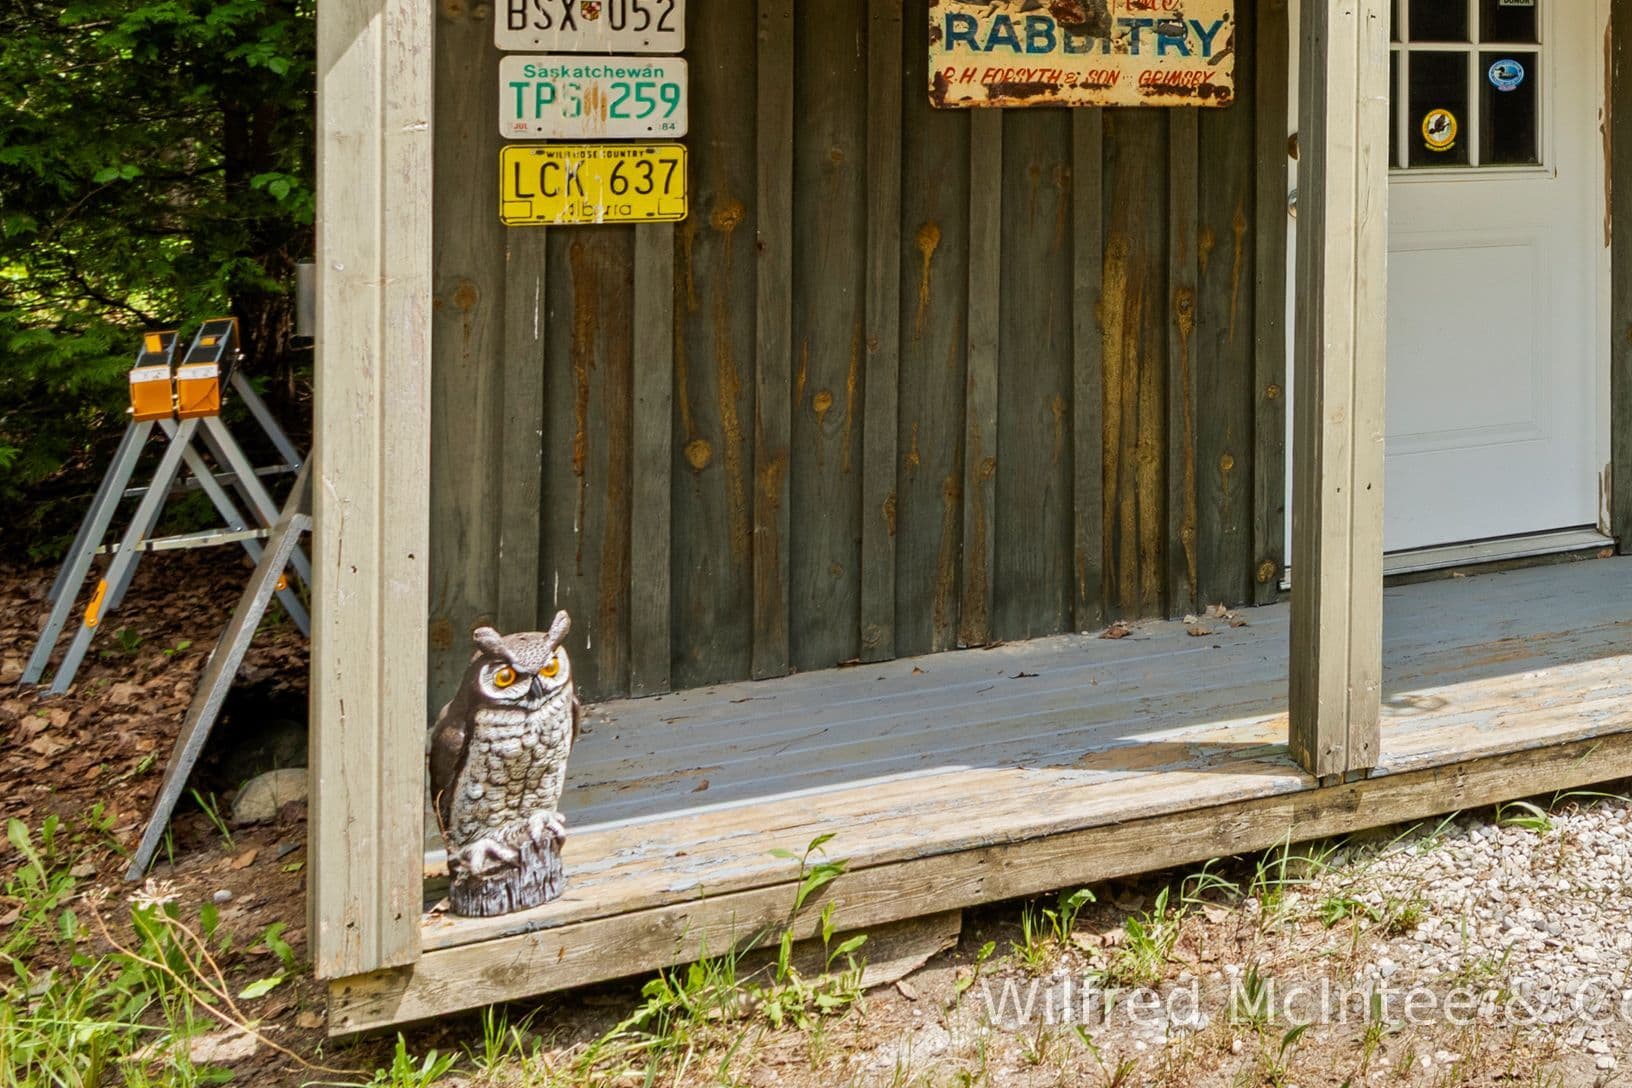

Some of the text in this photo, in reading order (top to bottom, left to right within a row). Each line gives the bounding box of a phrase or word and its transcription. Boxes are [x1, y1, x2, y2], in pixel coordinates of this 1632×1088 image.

[523, 64, 664, 78] Saskatchewan
[1088, 70, 1120, 85] SON
[1138, 70, 1216, 86] GRIMSBY
[609, 81, 680, 119] 259
[514, 160, 678, 199] LCK 637
[568, 201, 632, 216] Albrta
